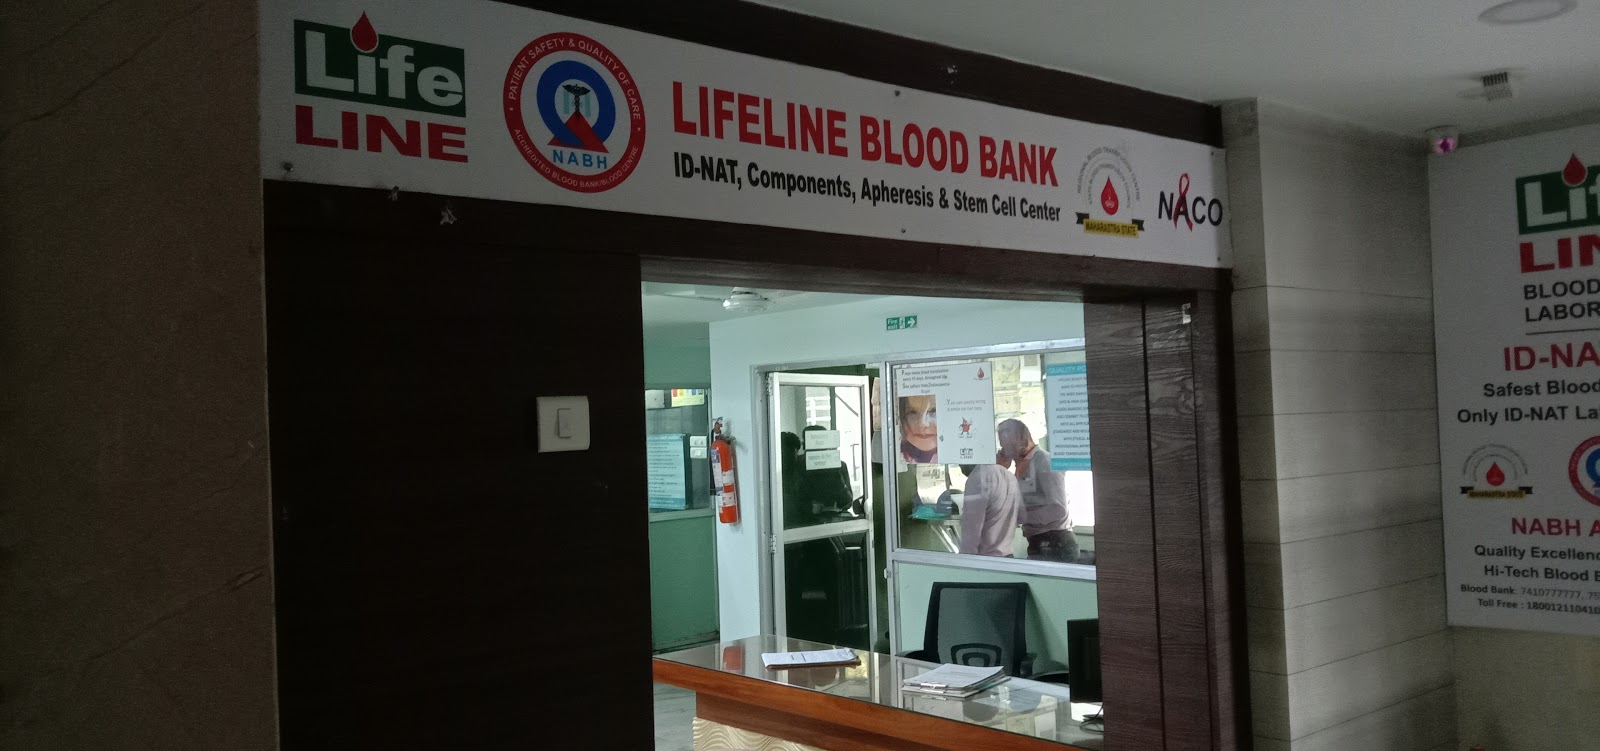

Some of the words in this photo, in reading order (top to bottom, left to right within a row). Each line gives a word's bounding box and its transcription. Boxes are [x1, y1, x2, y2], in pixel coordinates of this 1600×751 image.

[305, 30, 463, 107] Life
[508, 56, 530, 101] PATIENT
[528, 38, 565, 59] SAFETY
[568, 38, 576, 47] &
[578, 40, 620, 71] QUALITY
[618, 71, 629, 87] OF
[627, 88, 641, 120] CARE
[295, 104, 468, 163] LINE
[672, 81, 848, 158] LIFELINE
[860, 115, 969, 174] BLOOD
[979, 135, 1059, 187] BANK
[514, 128, 551, 174] ACCREDITED
[551, 171, 578, 187] BLOOD
[621, 145, 639, 172] CENTRE
[552, 149, 608, 170] NABH
[673, 152, 742, 191] ID-NAT,
[747, 162, 857, 204] Components,
[861, 177, 934, 208] Apheresis
[939, 187, 949, 209] &
[953, 189, 988, 213] Stem
[991, 194, 1017, 217] Cell
[1019, 198, 1061, 222] Center
[1158, 174, 1223, 232] NACO
[1121, 225, 1137, 236] STATE
[1523, 278, 1600, 300] BLOOD
[1525, 301, 1600, 322] LABOR
[1503, 342, 1600, 371] ID-NA
[1483, 382, 1542, 398] Safest
[1547, 379, 1600, 395] Blood
[1457, 408, 1498, 426] Only
[1504, 406, 1569, 422] ID-NAT
[1575, 405, 1600, 420] La
[1511, 517, 1581, 537] NABH
[1474, 544, 1526, 560] Quality
[1484, 565, 1539, 579] Hi-Tech
[1544, 567, 1589, 582] Blood
[1460, 584, 1488, 593] Blood
[1477, 598, 1493, 607] Toll
[1496, 600, 1518, 609] Free
